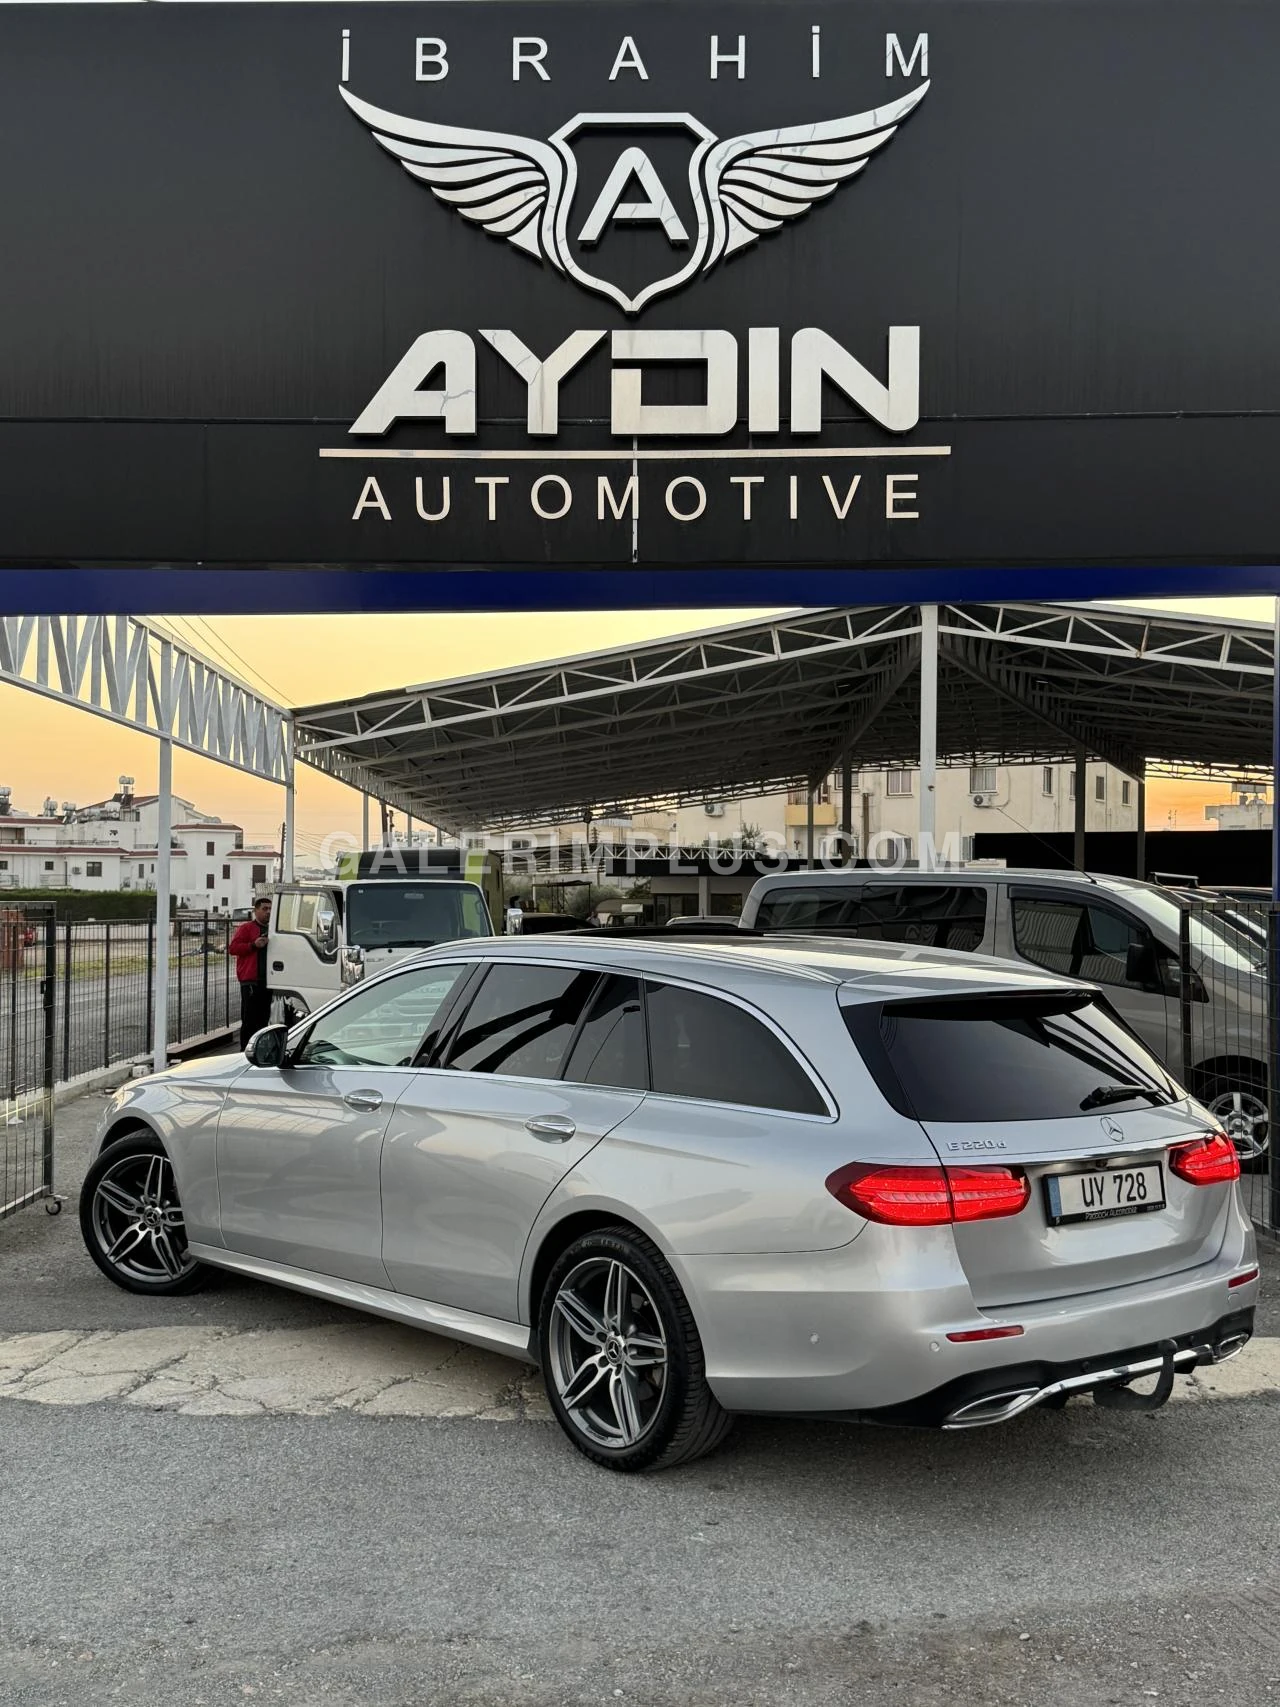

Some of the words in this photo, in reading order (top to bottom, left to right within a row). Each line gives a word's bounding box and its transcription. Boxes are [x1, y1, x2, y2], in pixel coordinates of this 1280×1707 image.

[340, 25, 931, 82] İBRAHİM
[576, 147, 690, 245] A
[348, 326, 921, 436] AYDIN
[351, 474, 921, 522] AUTOMOTIVE
[1081, 1175, 1106, 1208] UY
[1113, 1171, 1148, 1204] 728
